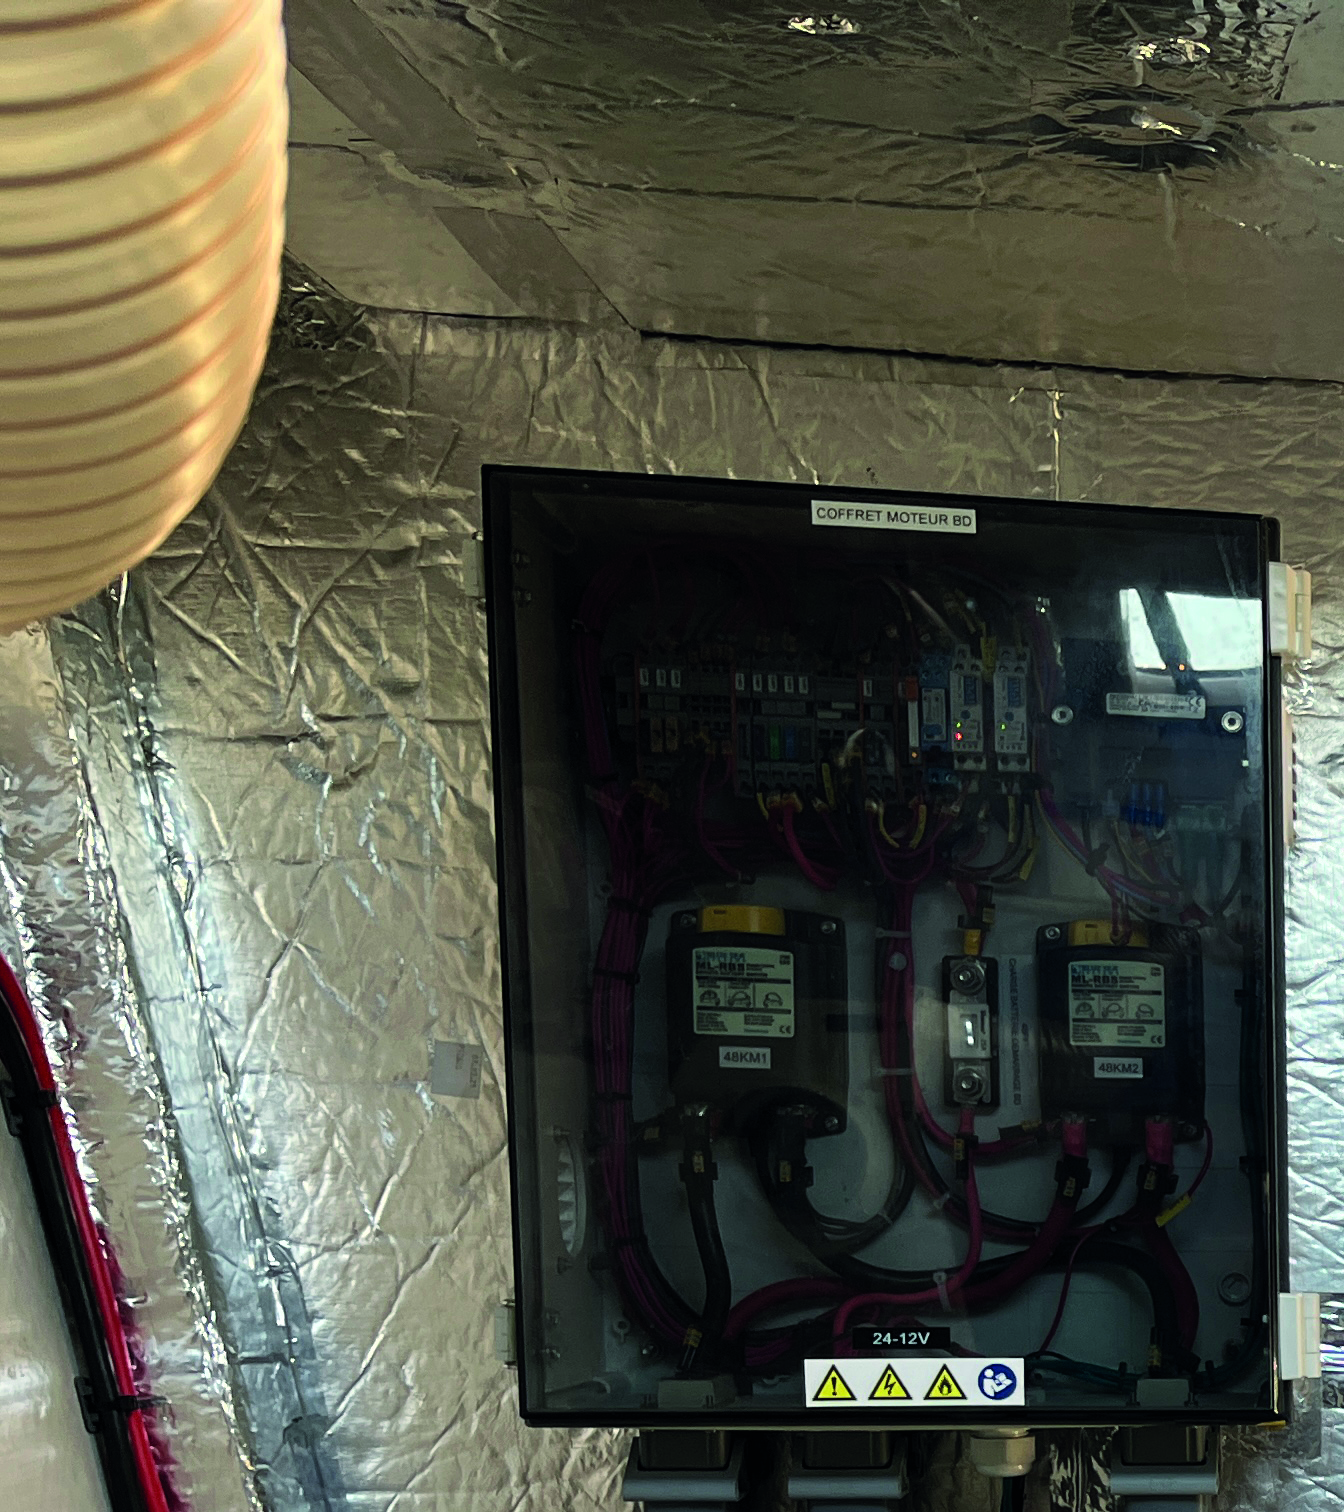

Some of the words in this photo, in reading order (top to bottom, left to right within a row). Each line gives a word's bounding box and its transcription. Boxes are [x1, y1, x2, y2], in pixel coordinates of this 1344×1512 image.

[816, 507, 882, 522] COFFRET
[887, 511, 948, 526] MOTEUR
[953, 515, 972, 527] BD
[723, 1051, 767, 1064] 48KM1
[1098, 1062, 1139, 1074] 48KM2
[872, 1332, 931, 1346] 24-12V
